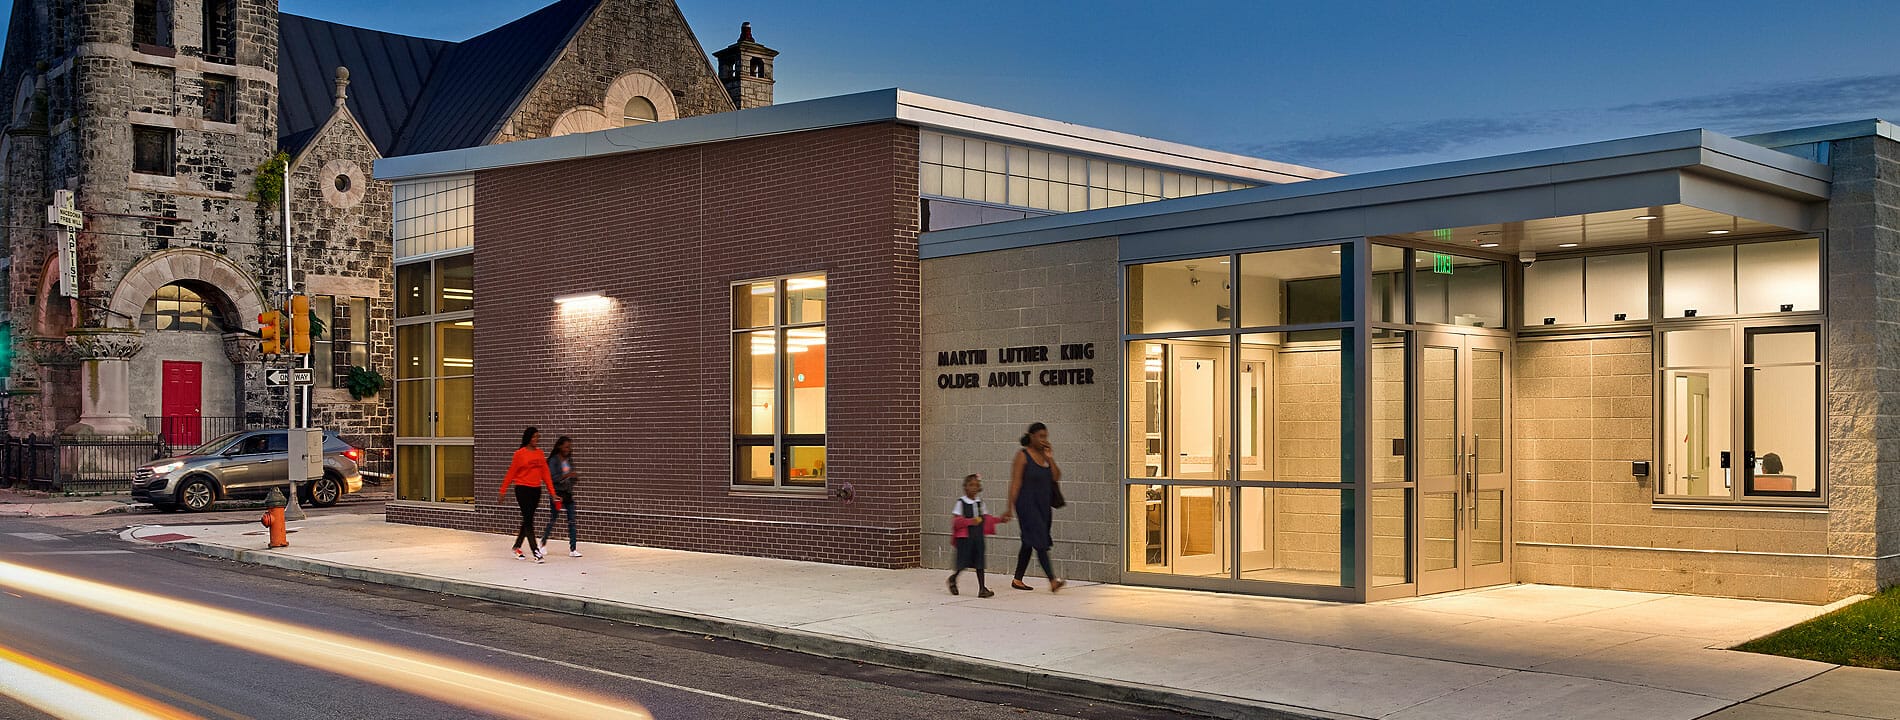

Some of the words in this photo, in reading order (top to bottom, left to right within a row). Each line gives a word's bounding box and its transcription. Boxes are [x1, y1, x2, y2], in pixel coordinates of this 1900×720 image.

[938, 349, 987, 366] MARTIN
[999, 346, 1048, 363] LUTHER
[1061, 343, 1094, 360] KING
[295, 373, 308, 381] WAY
[938, 373, 979, 389] OLDER
[988, 371, 1031, 387] ADULT
[1040, 368, 1094, 386] CENTER
